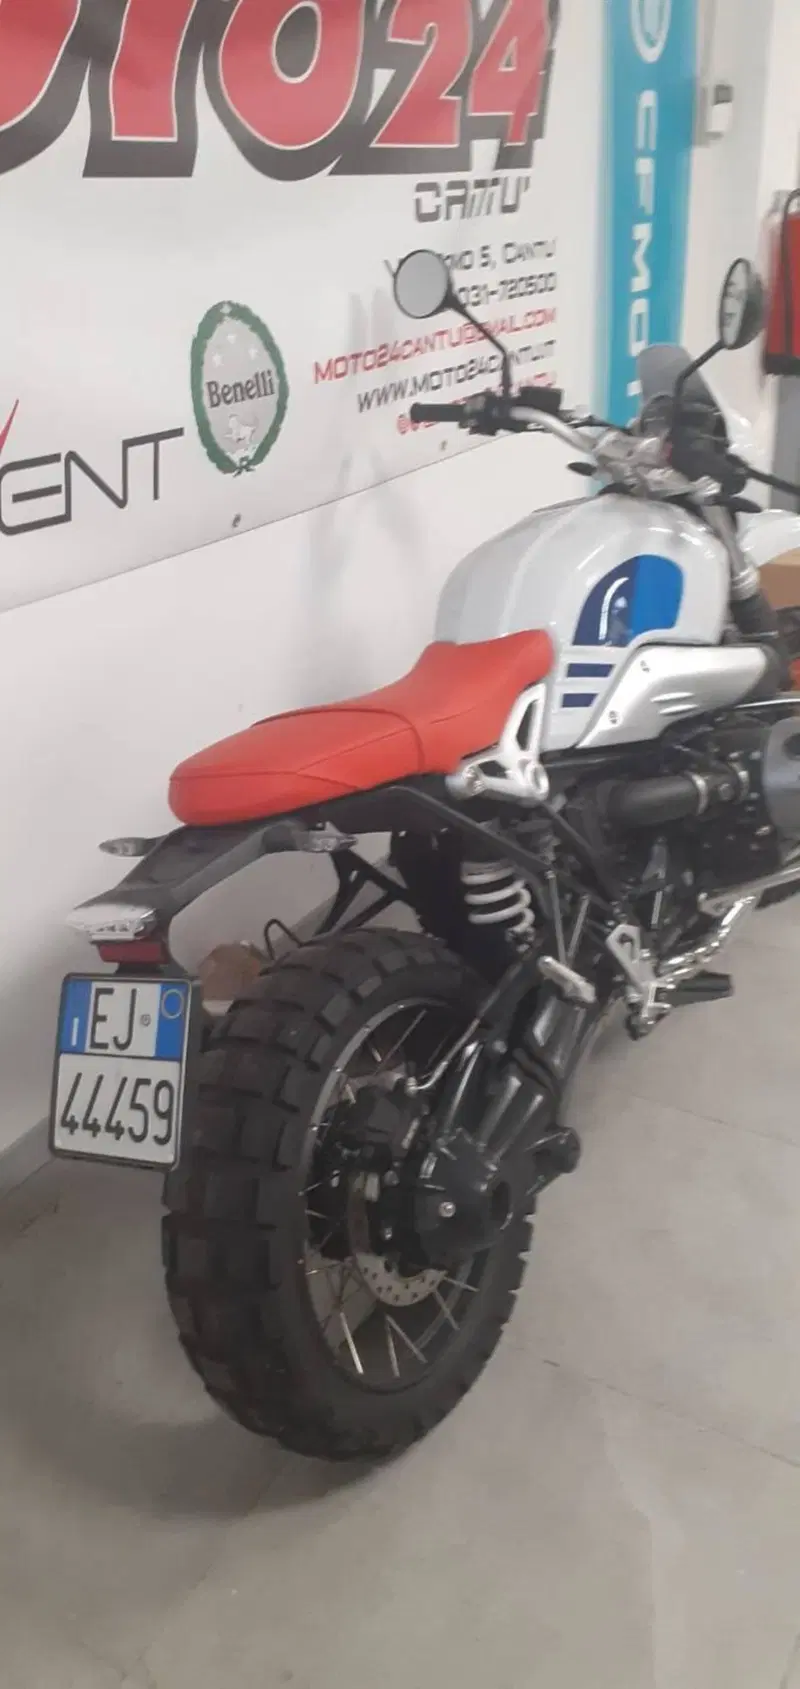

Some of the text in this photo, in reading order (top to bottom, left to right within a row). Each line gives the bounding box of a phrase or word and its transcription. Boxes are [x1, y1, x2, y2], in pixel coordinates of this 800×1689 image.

[625, 90, 657, 428] CFMO
[207, 369, 276, 409] Benelli
[357, 339, 557, 413] WWW.MOTO24CNTU.IT
[0, 400, 185, 536] ENT
[89, 987, 137, 1051] EJ
[60, 1071, 175, 1146] 44459
